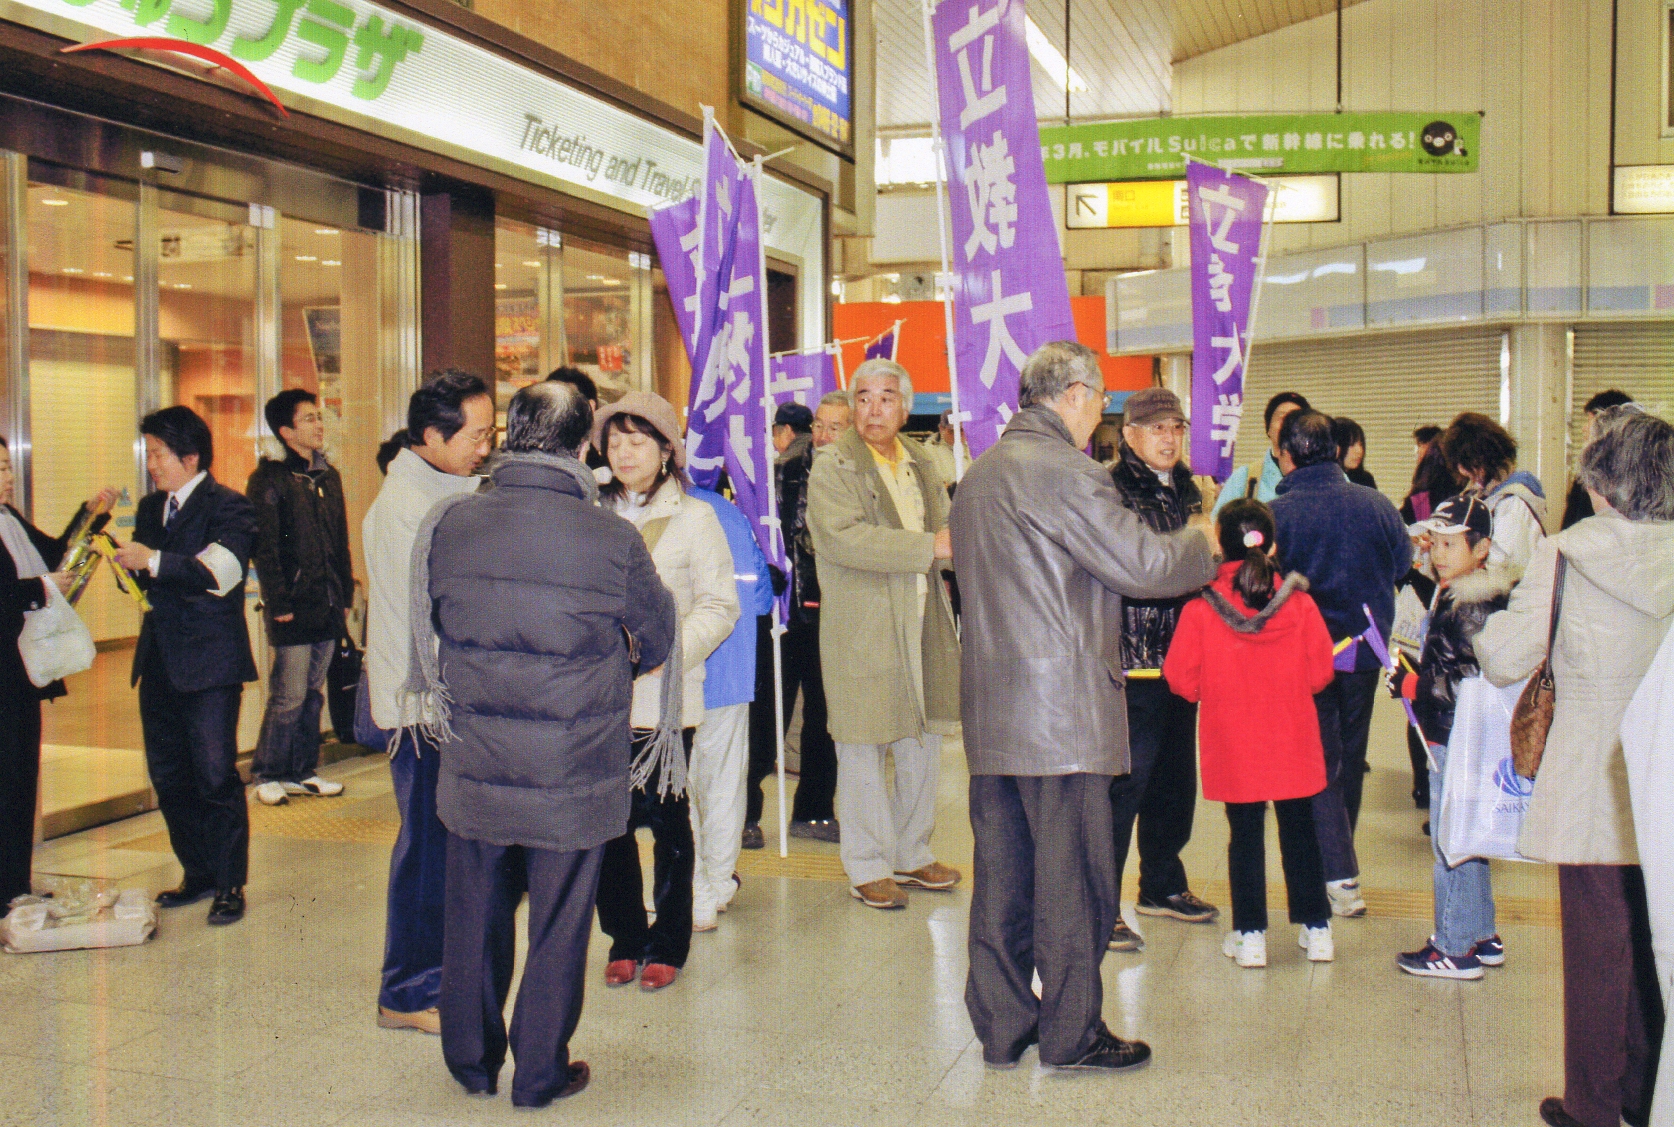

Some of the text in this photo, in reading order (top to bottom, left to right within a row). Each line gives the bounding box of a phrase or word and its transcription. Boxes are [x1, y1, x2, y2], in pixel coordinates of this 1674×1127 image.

[520, 113, 604, 182] Ticketing
[604, 156, 641, 187] and
[641, 160, 690, 200] Travel
